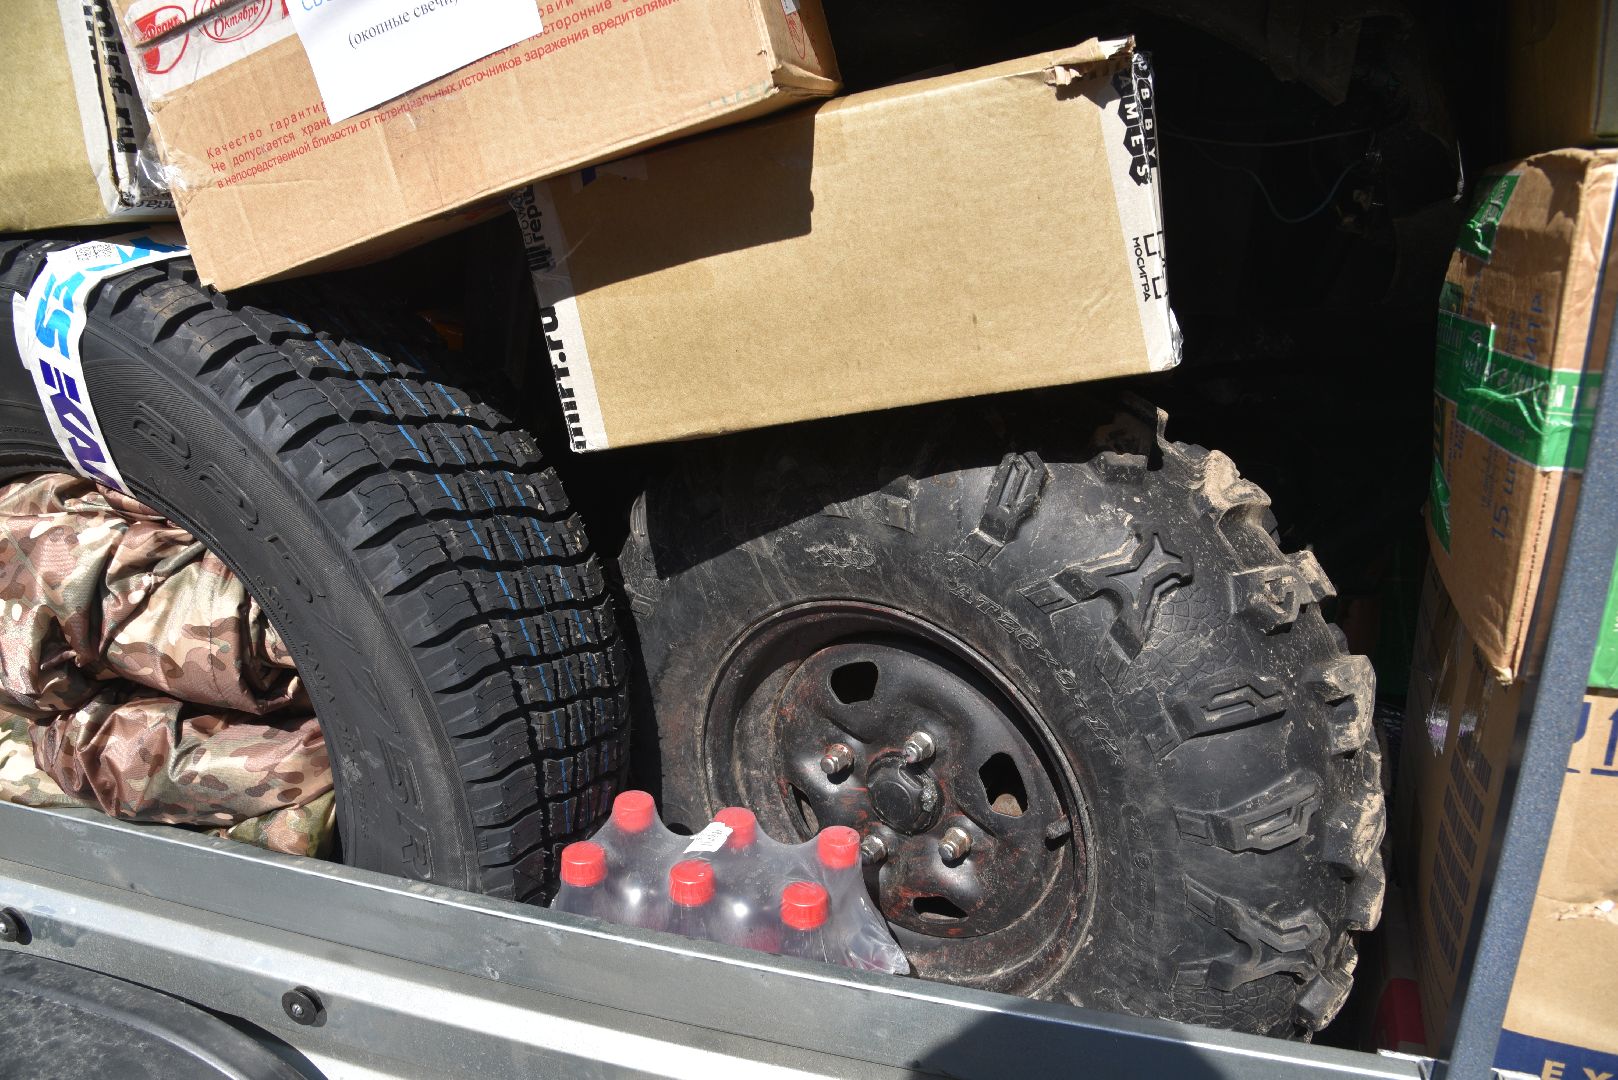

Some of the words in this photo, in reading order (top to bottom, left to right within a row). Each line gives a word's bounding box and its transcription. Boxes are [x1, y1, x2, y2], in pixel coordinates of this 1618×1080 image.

[213, 3, 259, 37] Октябрь
[348, 11, 411, 49] (окопные
[217, 180, 224, 189] в
[225, 141, 312, 186] непосредственной
[312, 123, 359, 149] близости
[359, 117, 373, 130] от
[374, 84, 457, 125] потенциальных
[458, 56, 522, 91] источников
[524, 27, 589, 62] заражения
[206, 127, 263, 159] Качество
[211, 162, 227, 174] Не
[232, 131, 296, 167] допускается
[301, 117, 331, 138] хране
[1132, 236, 1151, 303] МОСИГРА
